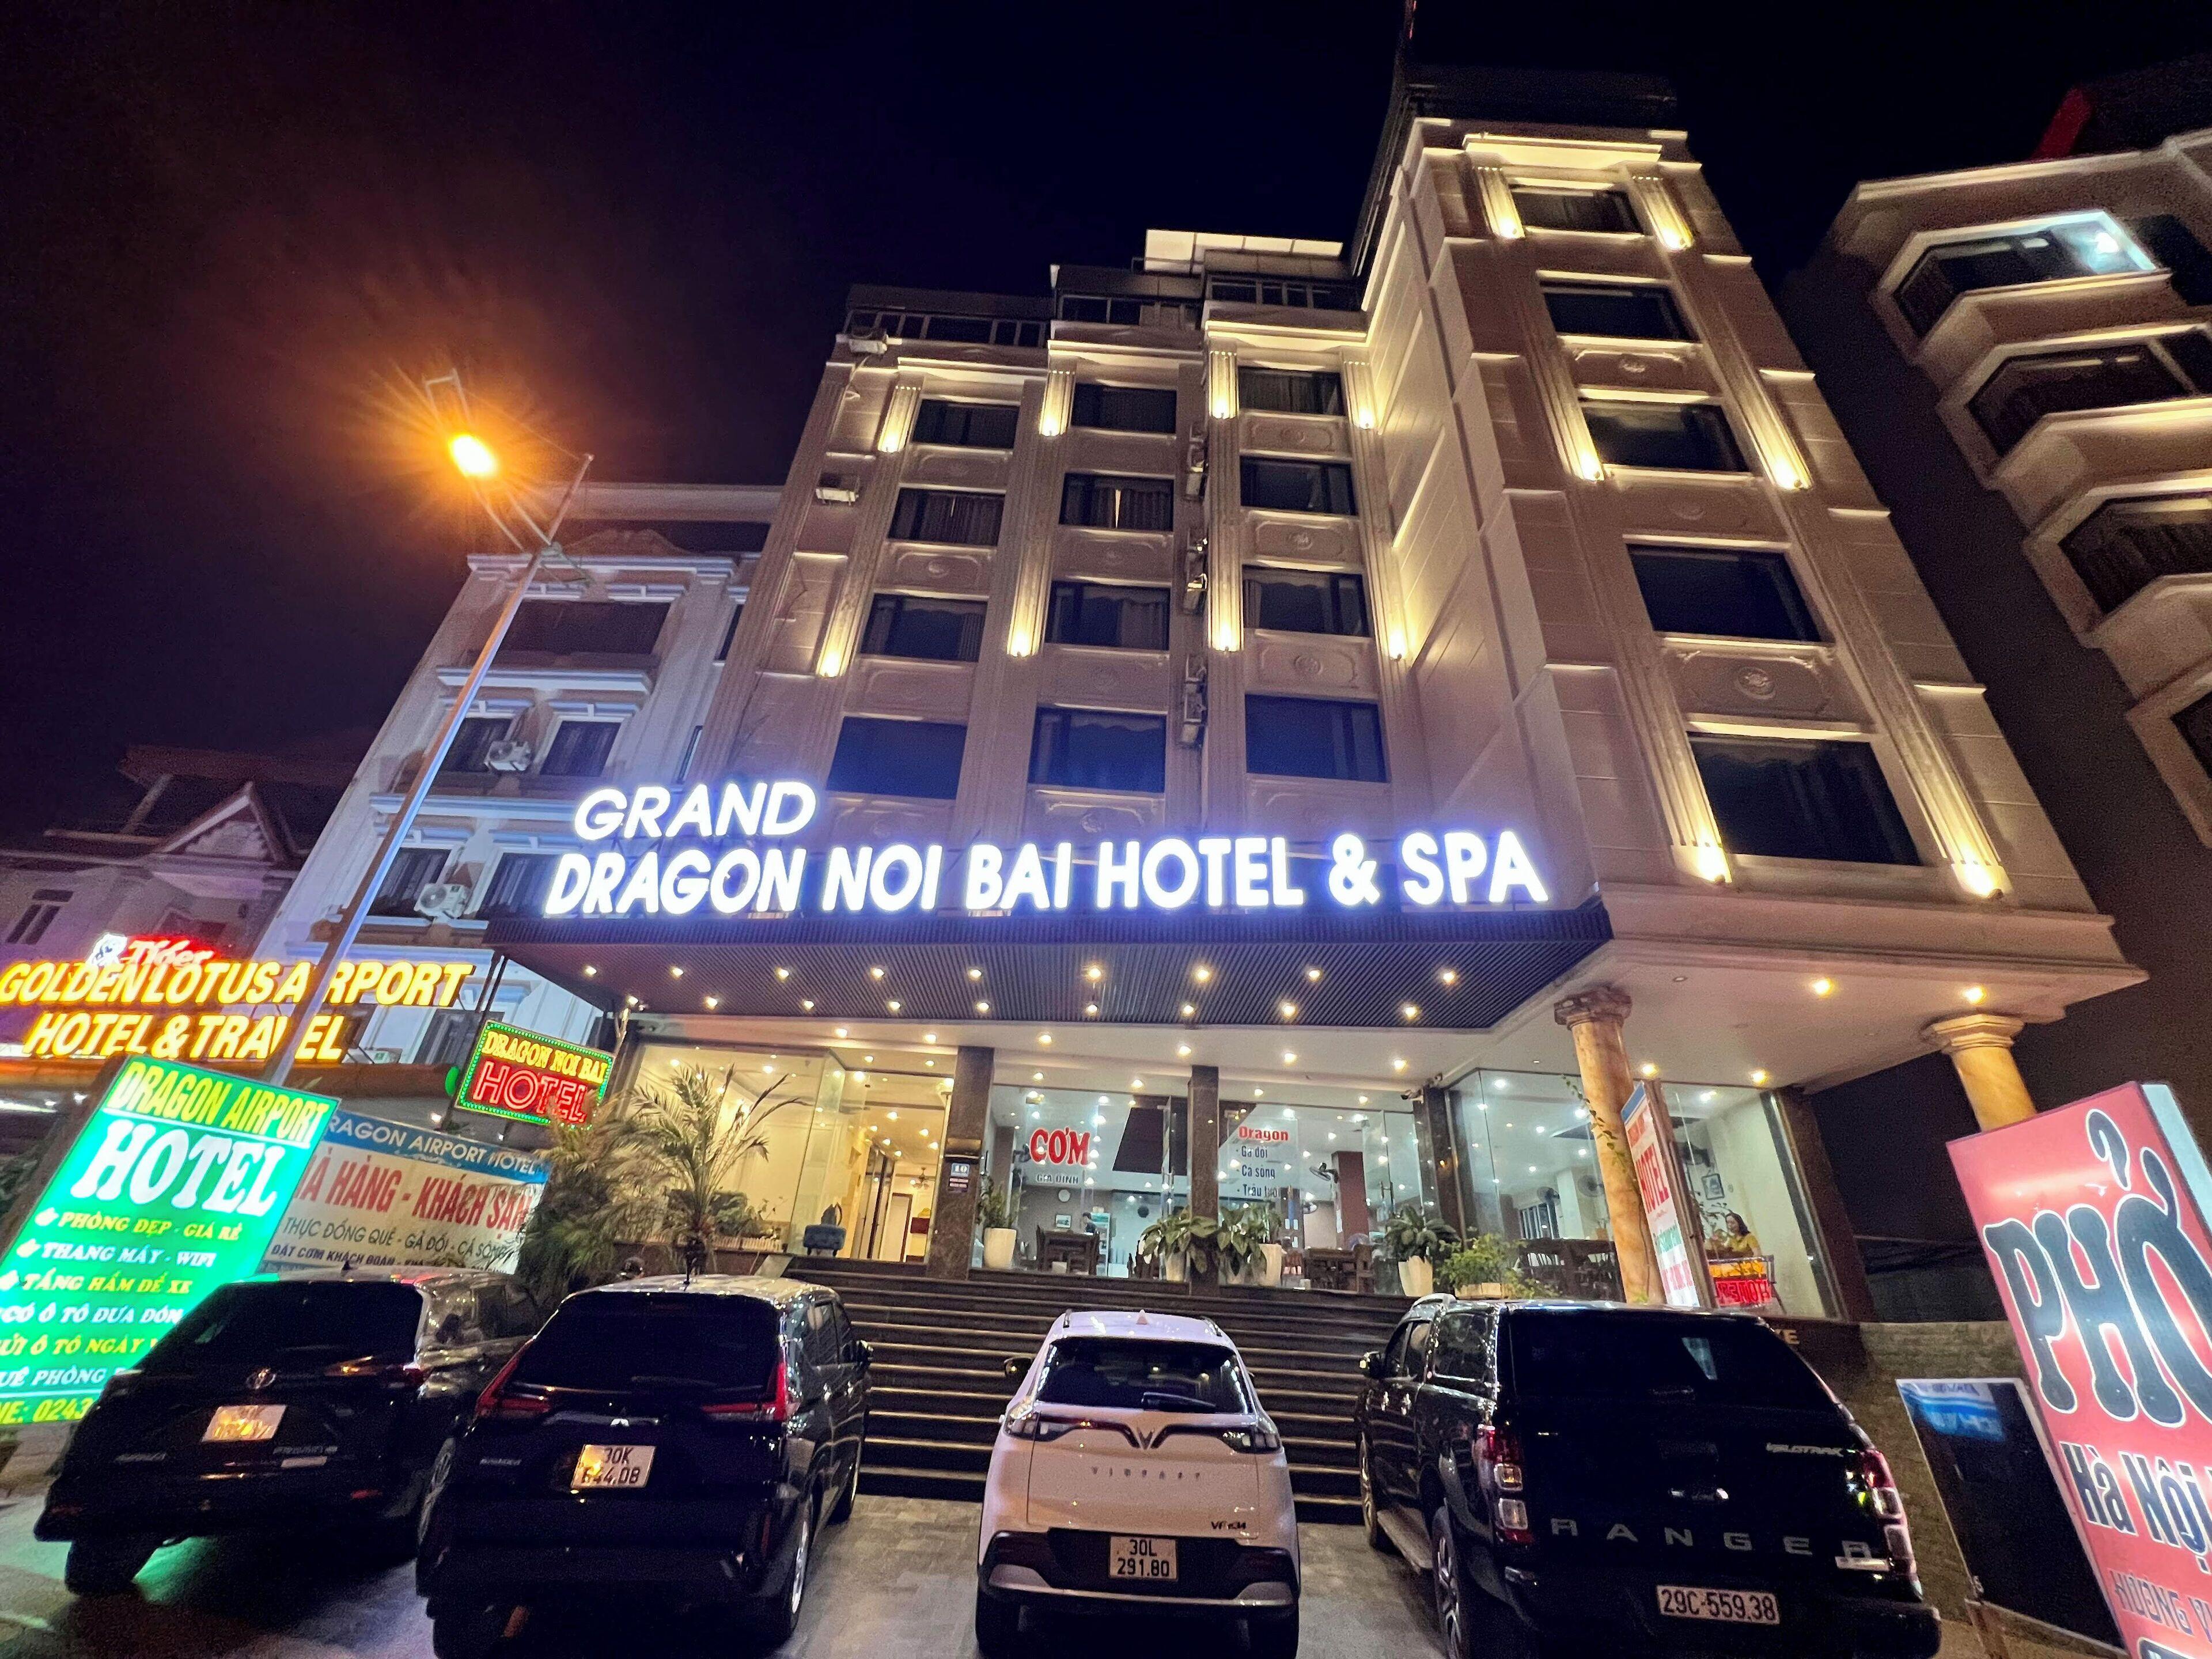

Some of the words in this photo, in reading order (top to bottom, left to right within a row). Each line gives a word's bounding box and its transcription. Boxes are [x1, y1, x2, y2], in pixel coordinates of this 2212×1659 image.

[574, 780, 818, 841] GRAND
[543, 847, 808, 915] DRAGON
[821, 843, 944, 912] NOI
[965, 842, 1073, 911] BAI
[1096, 836, 1305, 910] HOTEL
[1327, 833, 1380, 907] &
[1401, 830, 1550, 904] SPA
[142, 961, 281, 1003] LOTUS
[272, 961, 474, 1006] ARPORT
[24, 1013, 150, 1056] HOTEL
[152, 1015, 192, 1059] &
[481, 1031, 552, 1069] DRAGON
[107, 1061, 232, 1124] DRAGON
[221, 1086, 329, 1143] AIRPORT
[472, 1061, 587, 1122] HOTEL
[327, 1116, 407, 1147] RAGON
[408, 1136, 485, 1164] AIRPORT
[1238, 1126, 1289, 1142] Dragon
[70, 1119, 285, 1217] HOTEL
[1636, 1143, 1669, 1213] HOTEL
[412, 1173, 490, 1226] KHÁCH
[41, 1242, 115, 1262] THANG
[176, 1252, 217, 1267] WIFI
[166, 1280, 194, 1294] XE
[2058, 1441, 2138, 1536] Hà
[1129, 1539, 1157, 1556] 30L
[1551, 1518, 1873, 1560] RANGER
[1118, 1558, 1169, 1577] 291.80
[1661, 1589, 1776, 1621] 29C-559.38
